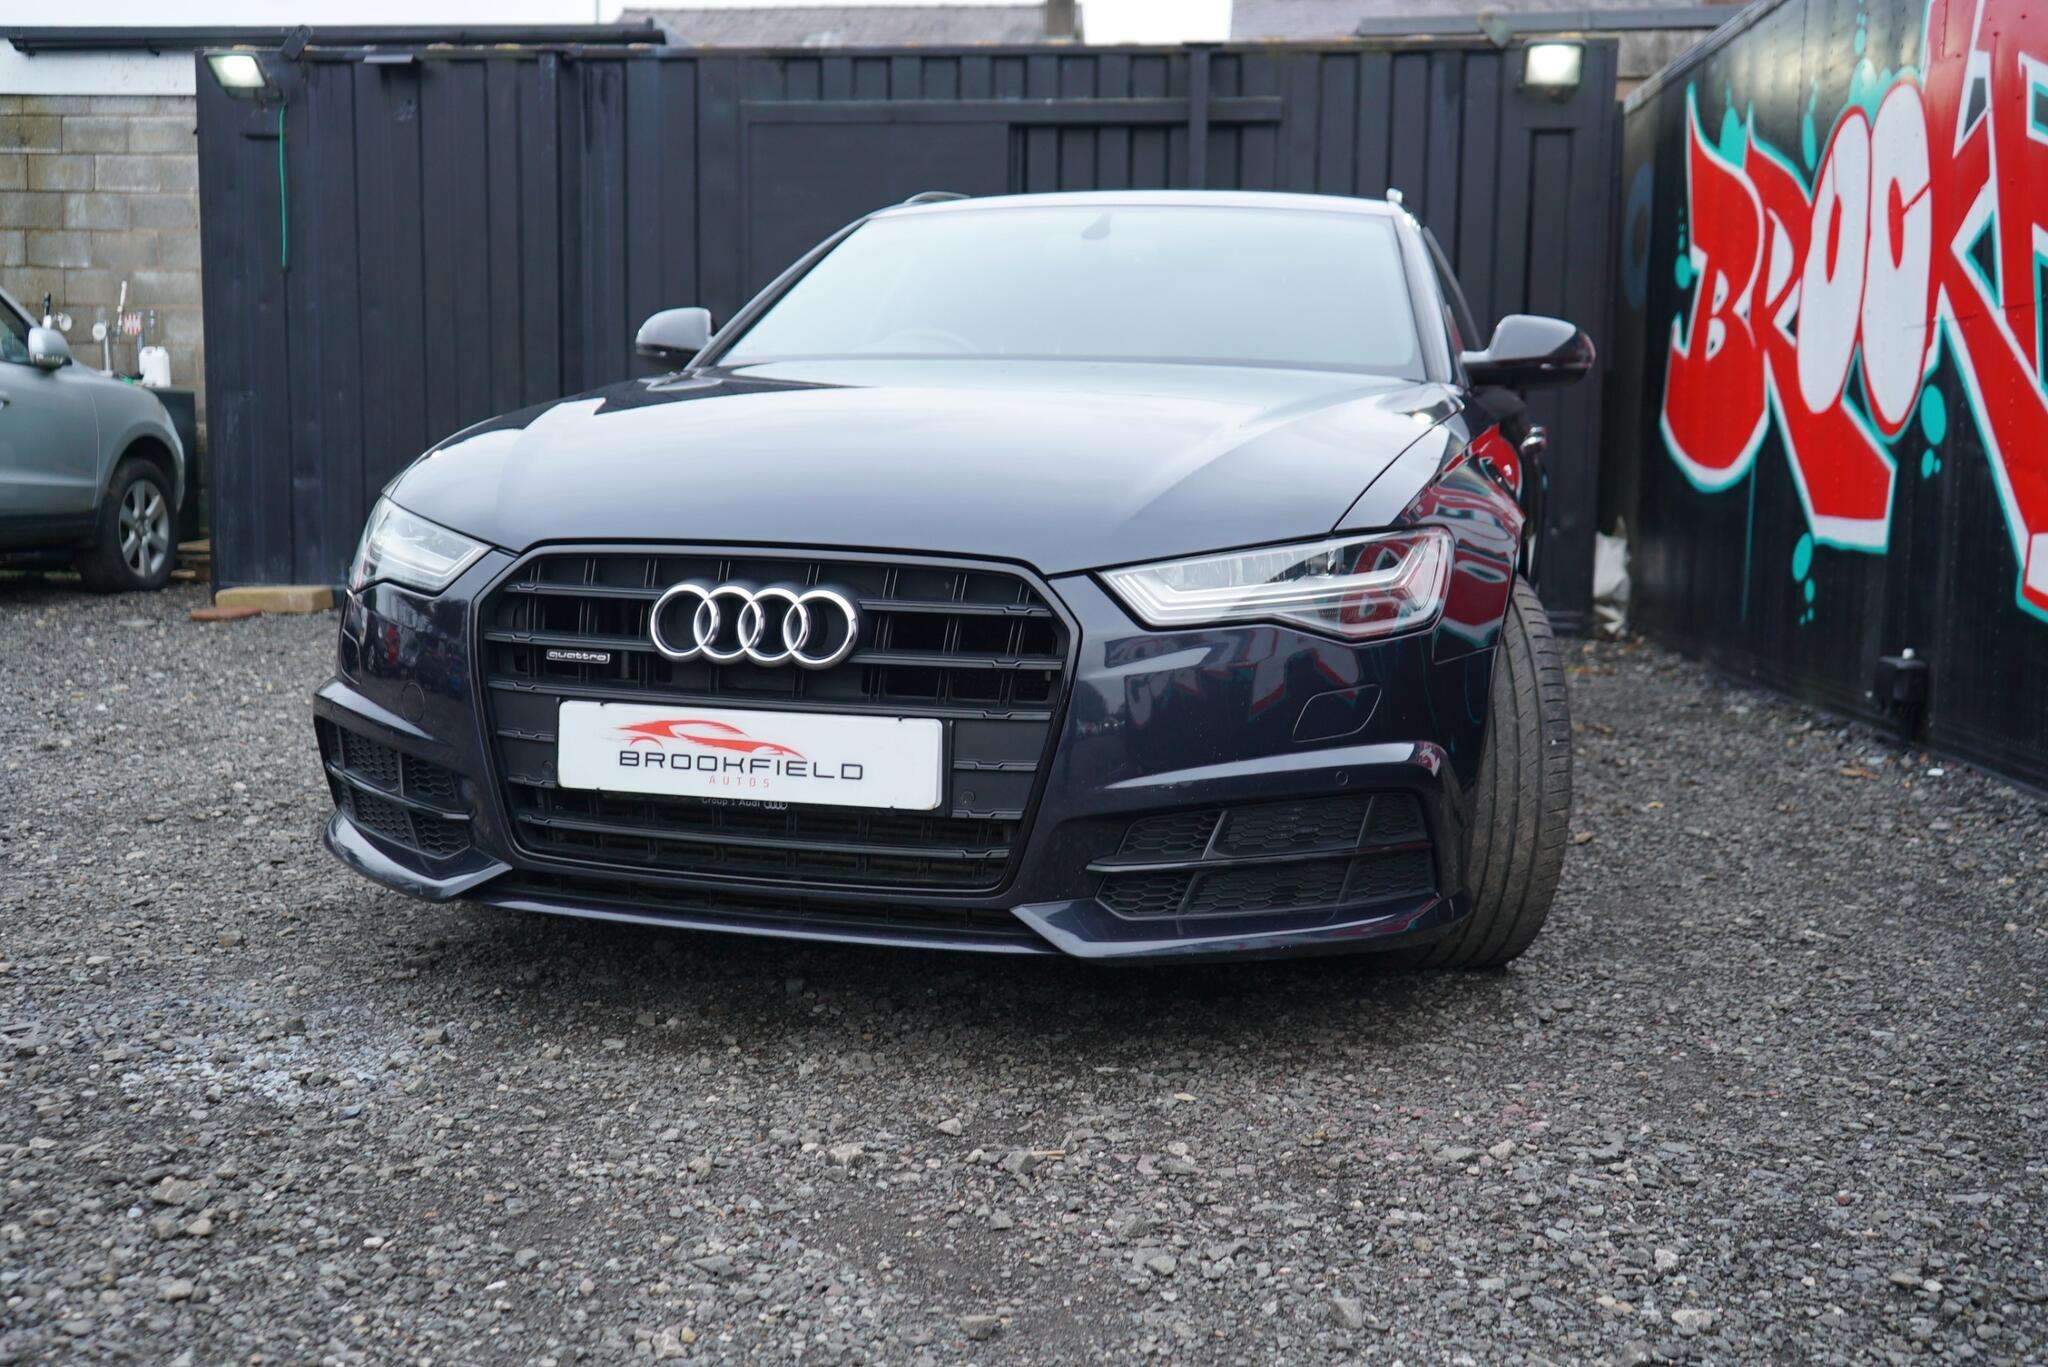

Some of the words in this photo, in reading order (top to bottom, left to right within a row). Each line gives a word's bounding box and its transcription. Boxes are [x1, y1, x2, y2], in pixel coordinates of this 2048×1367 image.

[547, 650, 607, 661] quattro
[619, 750, 864, 780] BROOKFIELD
[708, 775, 770, 788] AUTOS
